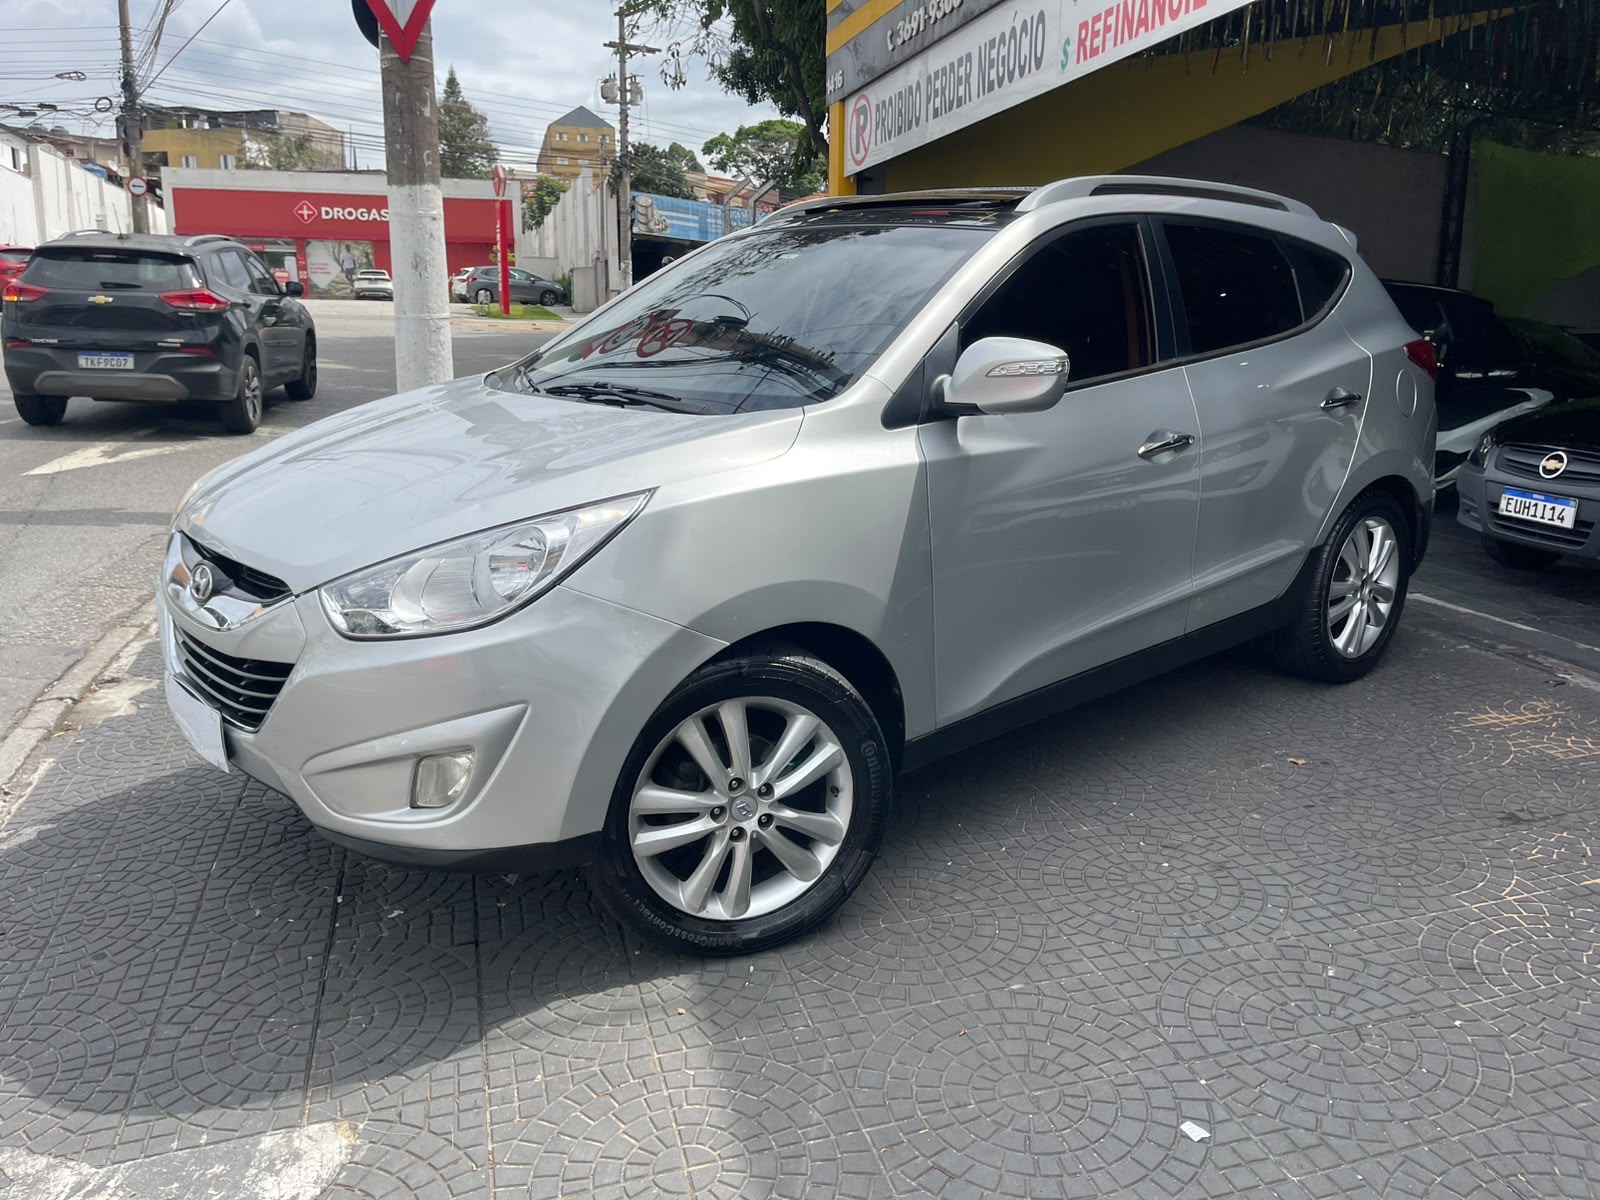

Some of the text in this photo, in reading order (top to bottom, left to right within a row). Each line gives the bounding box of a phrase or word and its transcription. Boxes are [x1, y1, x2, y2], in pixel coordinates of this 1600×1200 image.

[1076, 0, 1208, 64] REFINAN
[875, 80, 922, 146] PROIBIDO
[925, 51, 972, 123] PERDER
[977, 9, 1046, 99] NEGÓCIO
[321, 207, 389, 221] DROGAS
[1505, 497, 1566, 524] EUH1I14
